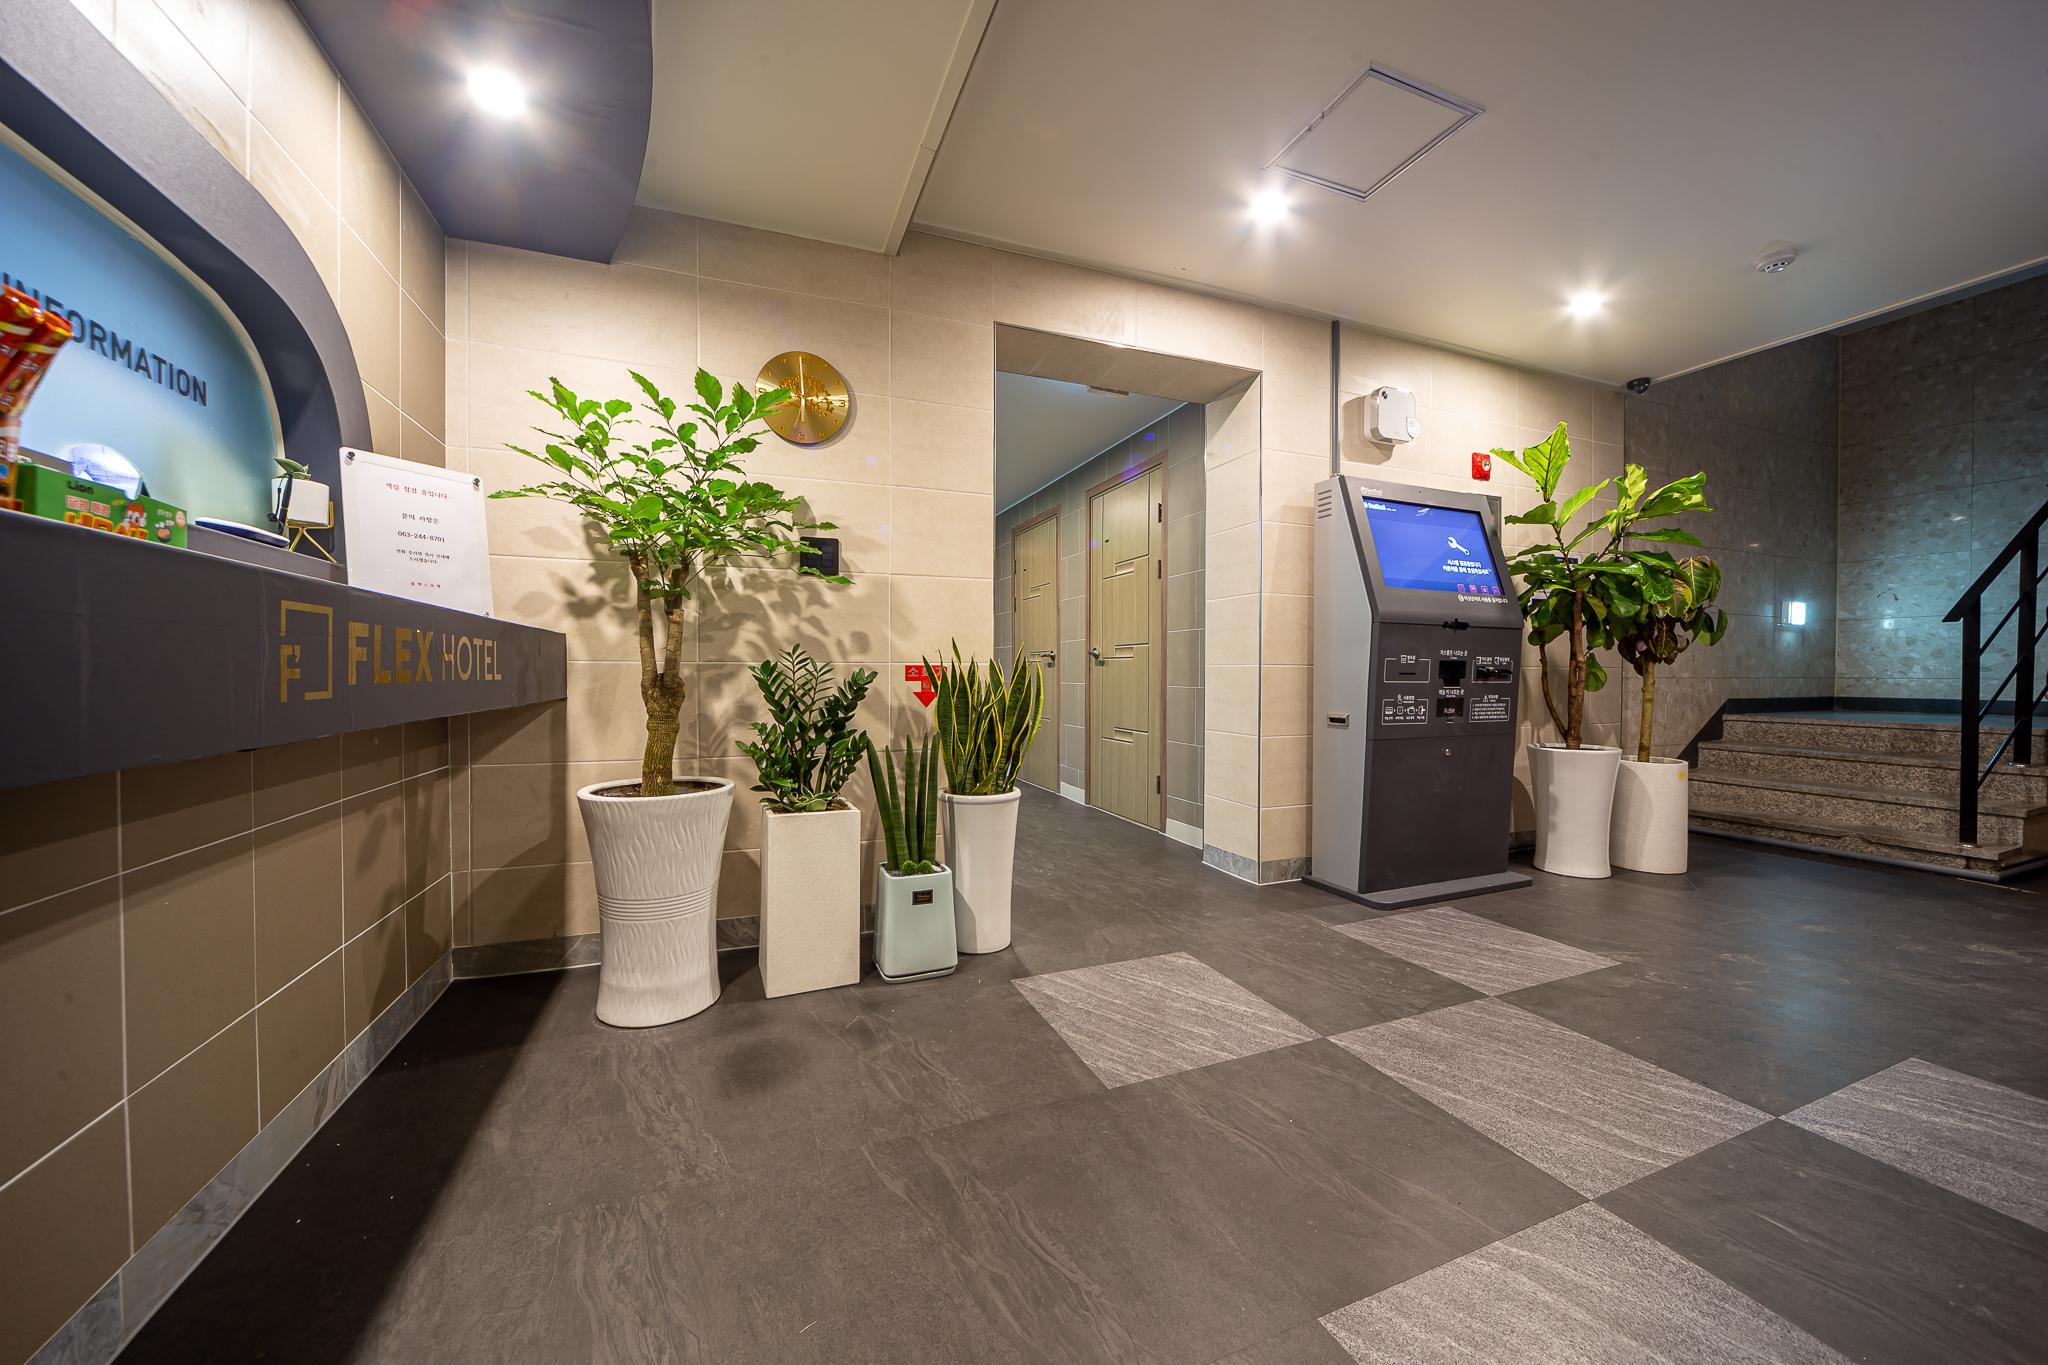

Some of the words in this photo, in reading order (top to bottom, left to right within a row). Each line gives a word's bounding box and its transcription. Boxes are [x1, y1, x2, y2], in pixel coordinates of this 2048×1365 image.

[421, 489, 448, 500] 중입니다
[402, 512, 415, 521] 문의
[419, 515, 439, 525] 사항은
[348, 621, 433, 686] FLEX
[441, 633, 502, 681] HOTEL
